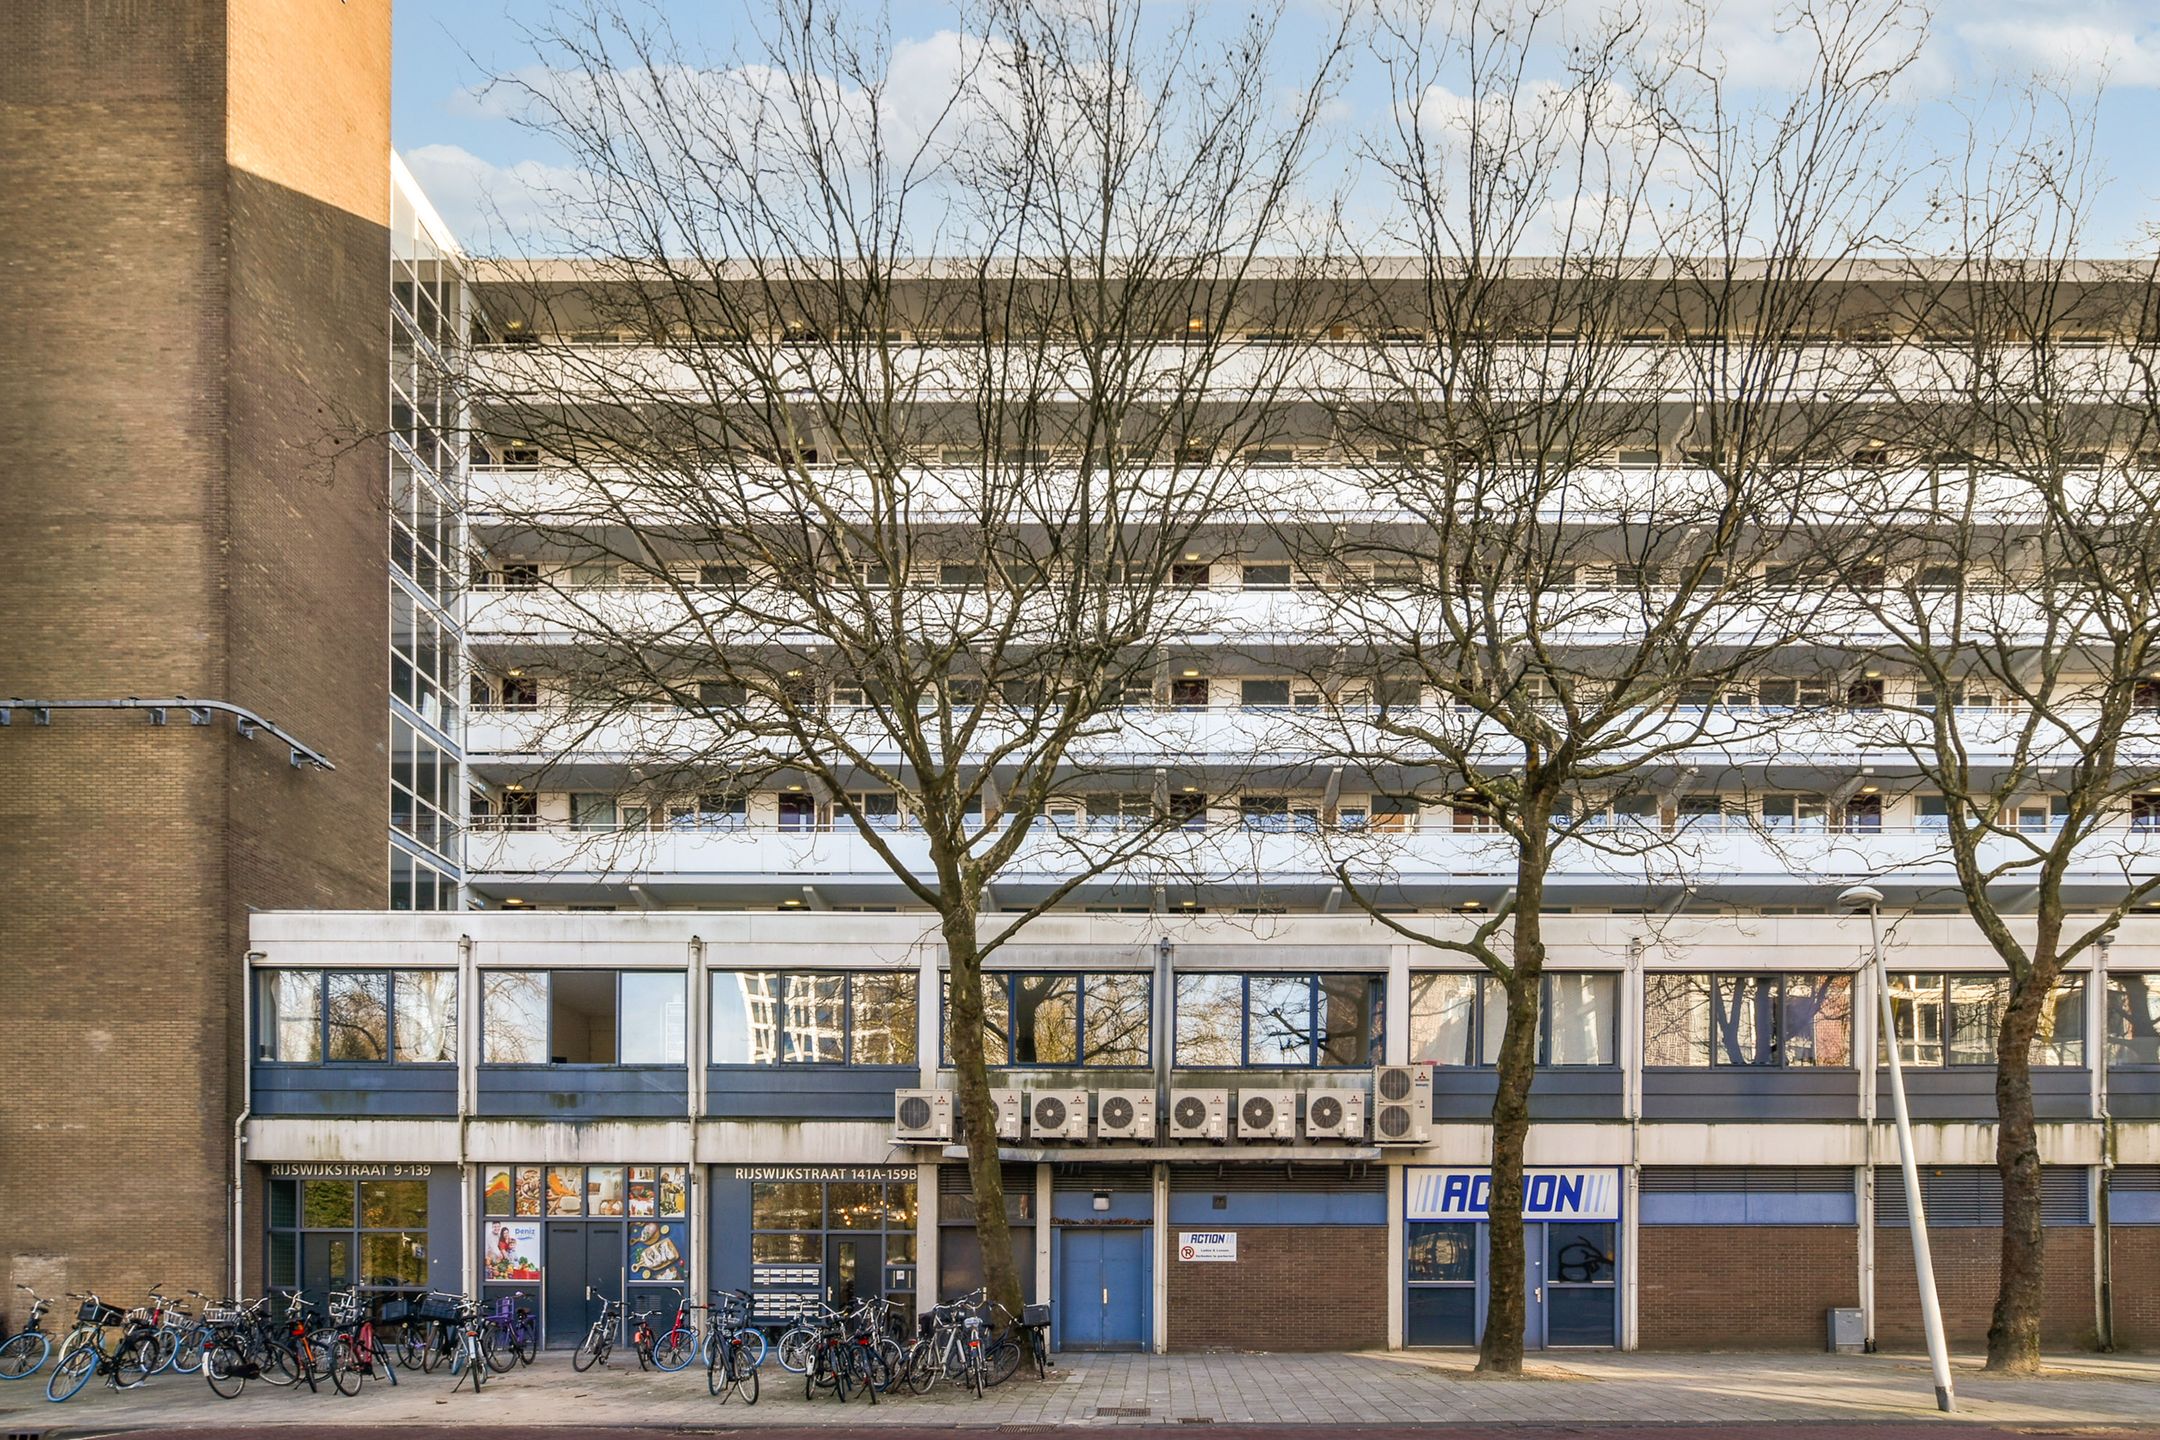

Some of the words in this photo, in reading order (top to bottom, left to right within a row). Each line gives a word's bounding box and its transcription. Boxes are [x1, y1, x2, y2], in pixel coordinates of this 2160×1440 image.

[271, 1164, 388, 1176] RIJSWIJKSTRAAT
[394, 1165, 432, 1176] 9-139
[735, 1168, 847, 1180] RIJSWIJKSTRAAT
[851, 1168, 918, 1180] 141A-159B
[1441, 1175, 1584, 1212] ACION
[1190, 1234, 1225, 1244] ACTION
